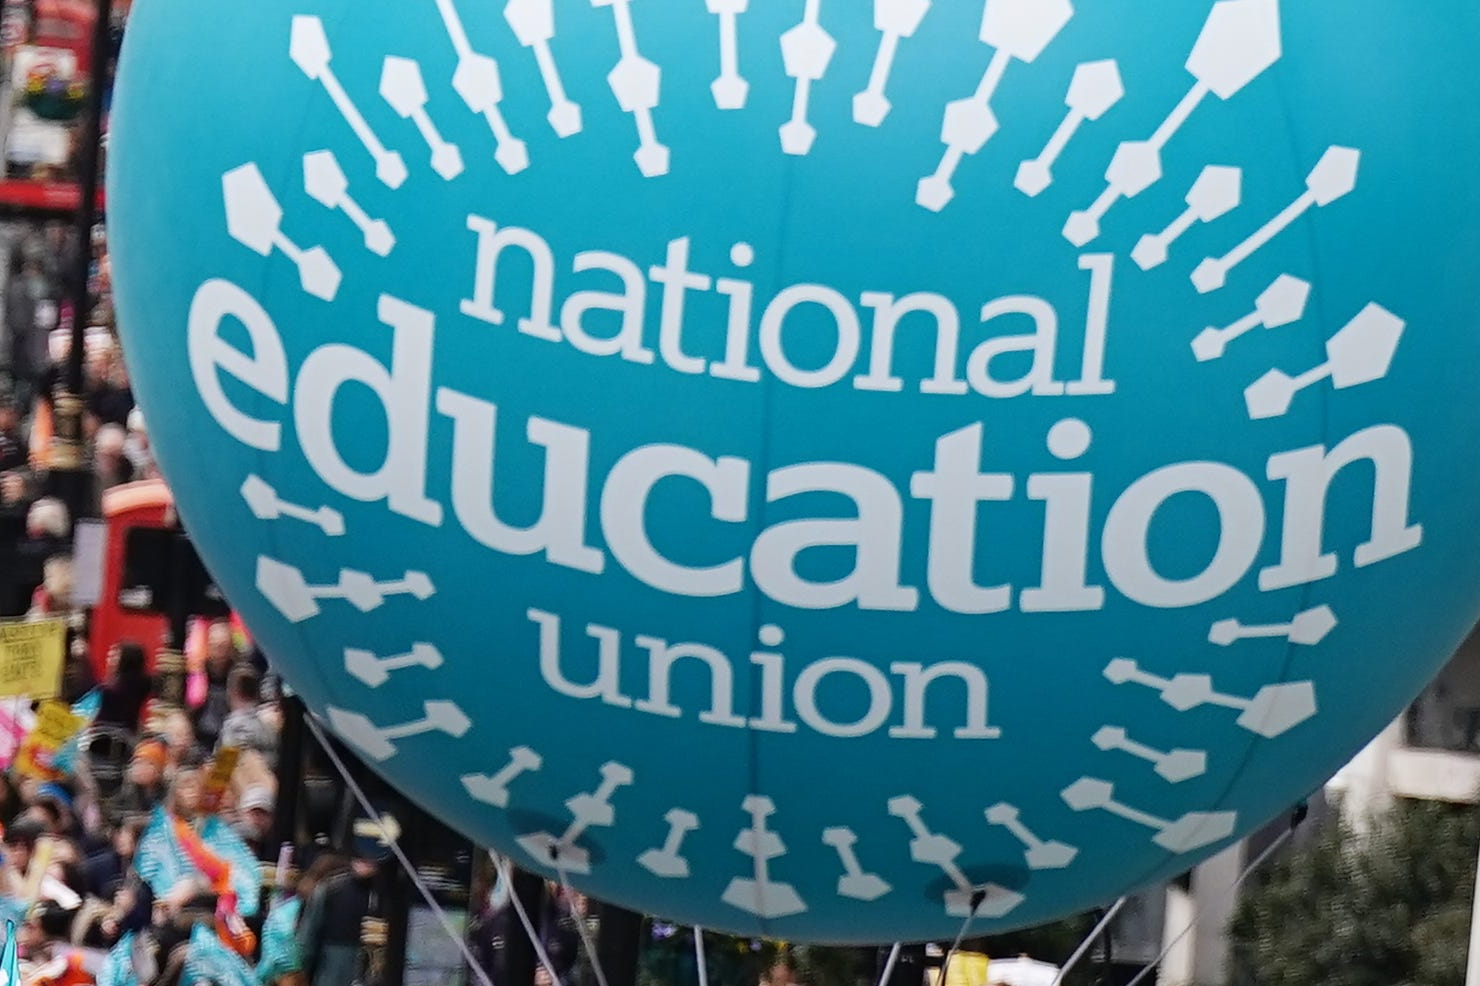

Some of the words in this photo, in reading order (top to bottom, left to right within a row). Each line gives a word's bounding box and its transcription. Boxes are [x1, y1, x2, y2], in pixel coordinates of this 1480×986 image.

[458, 213, 1116, 400] national
[187, 277, 1424, 616] education
[527, 608, 1003, 741] union
